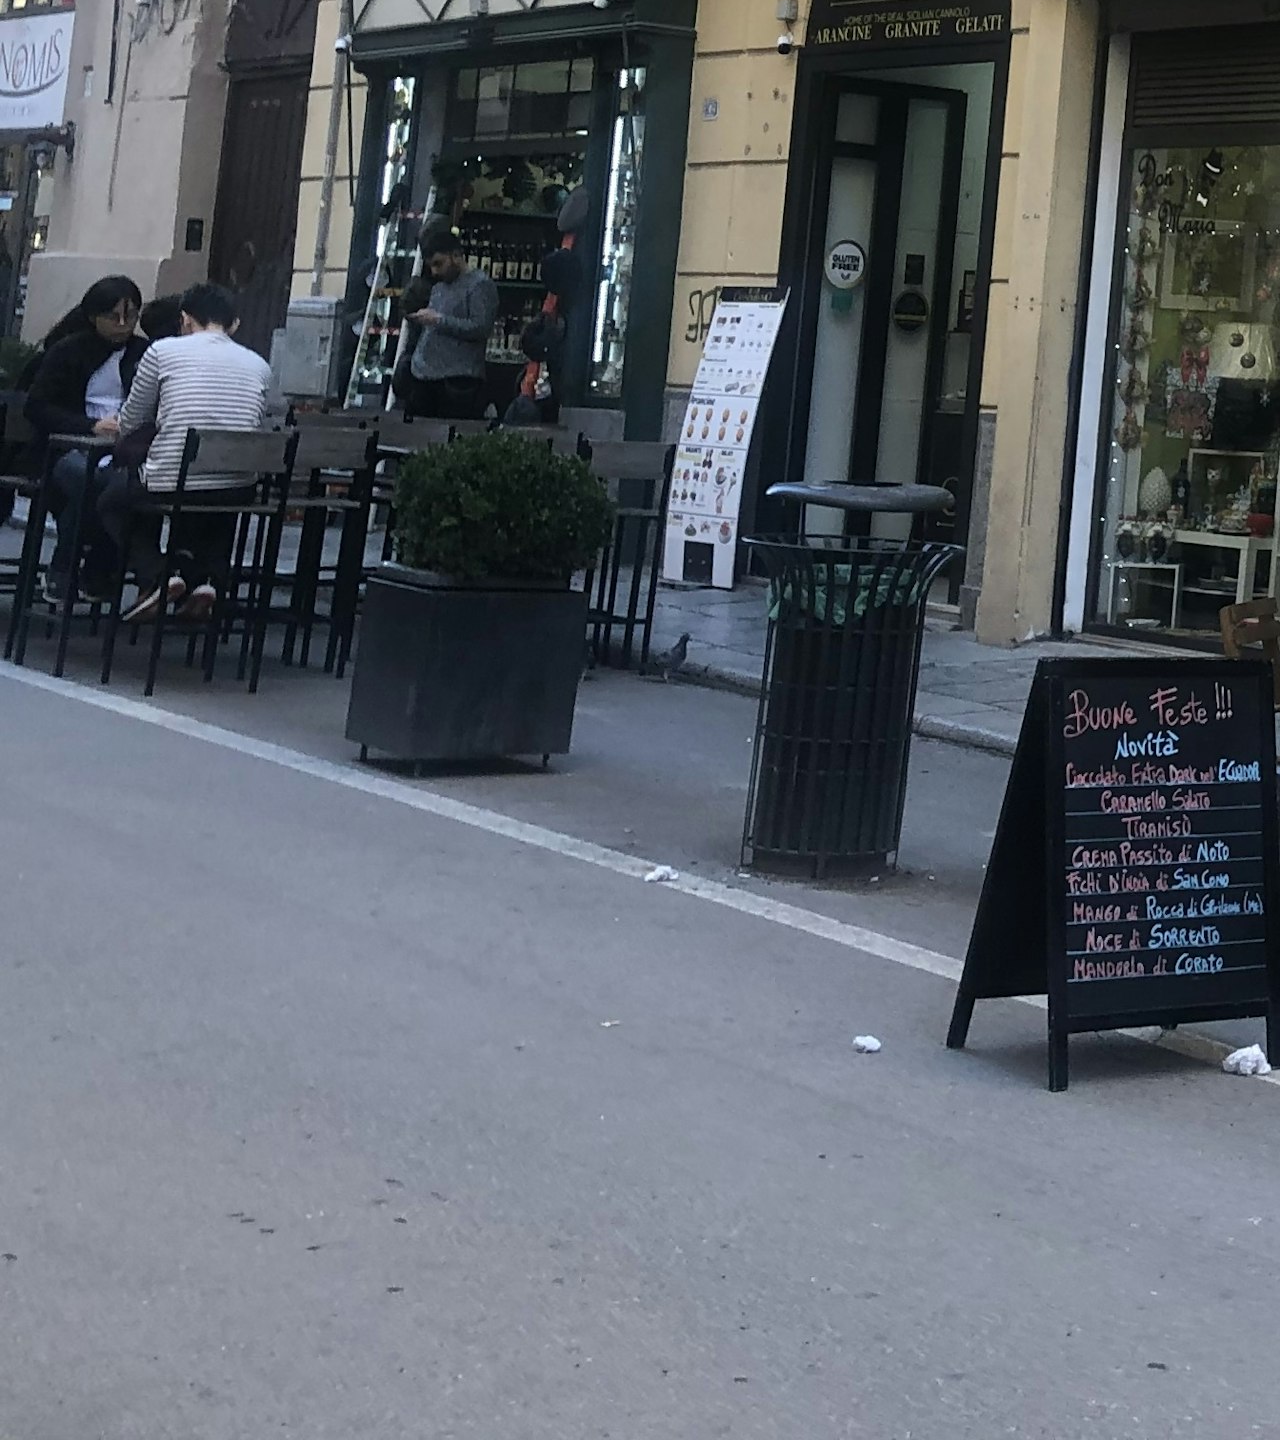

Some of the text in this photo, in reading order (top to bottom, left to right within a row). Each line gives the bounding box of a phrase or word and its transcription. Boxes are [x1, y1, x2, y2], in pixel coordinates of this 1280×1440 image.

[874, 13, 886, 23] THE
[906, 9, 934, 21] SICILIAN
[935, 7, 971, 20] CANNOLO
[814, 14, 1003, 45] ARANCINE GRANITE GELATI
[831, 262, 860, 271] FREE
[832, 253, 860, 263] GLUTEN
[1114, 729, 1180, 761] Novità
[1178, 844, 1192, 862] di
[1156, 871, 1170, 892] di
[1073, 901, 1121, 924] MANGO
[1126, 905, 1138, 921] di
[1187, 897, 1199, 916] di
[1128, 928, 1141, 950] di
[1153, 954, 1168, 974] di
